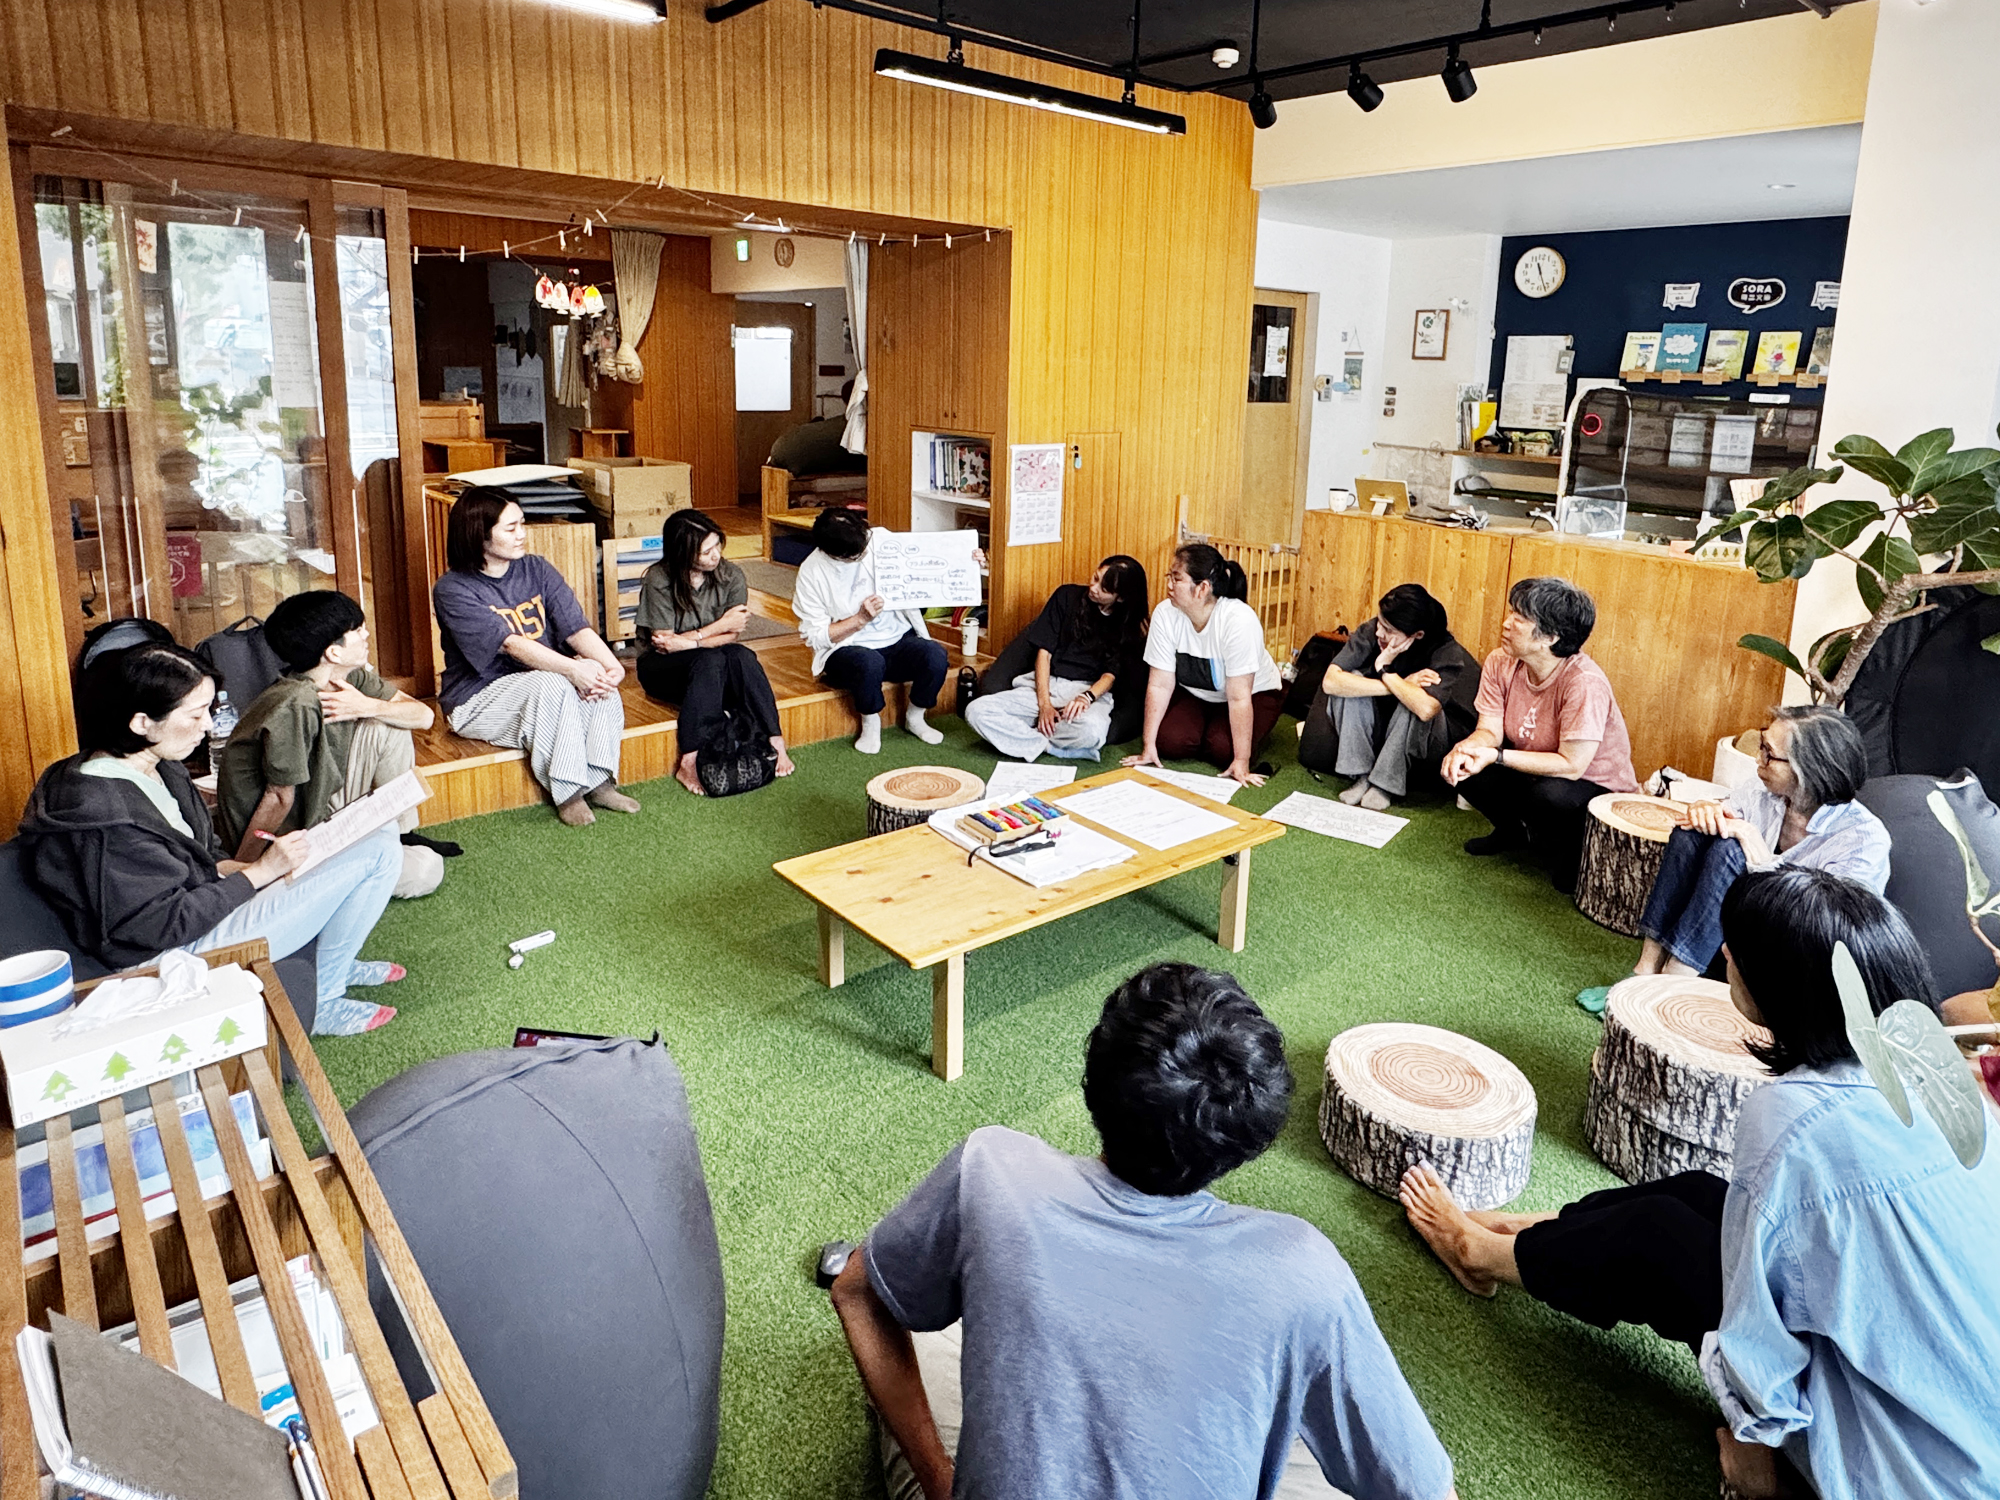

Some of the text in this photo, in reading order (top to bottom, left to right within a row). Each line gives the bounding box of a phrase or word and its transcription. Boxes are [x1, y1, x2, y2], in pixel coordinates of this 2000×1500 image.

[1742, 284, 1772, 293] SORA
[64, 1067, 174, 1108] Tissue Paper Slim Box
